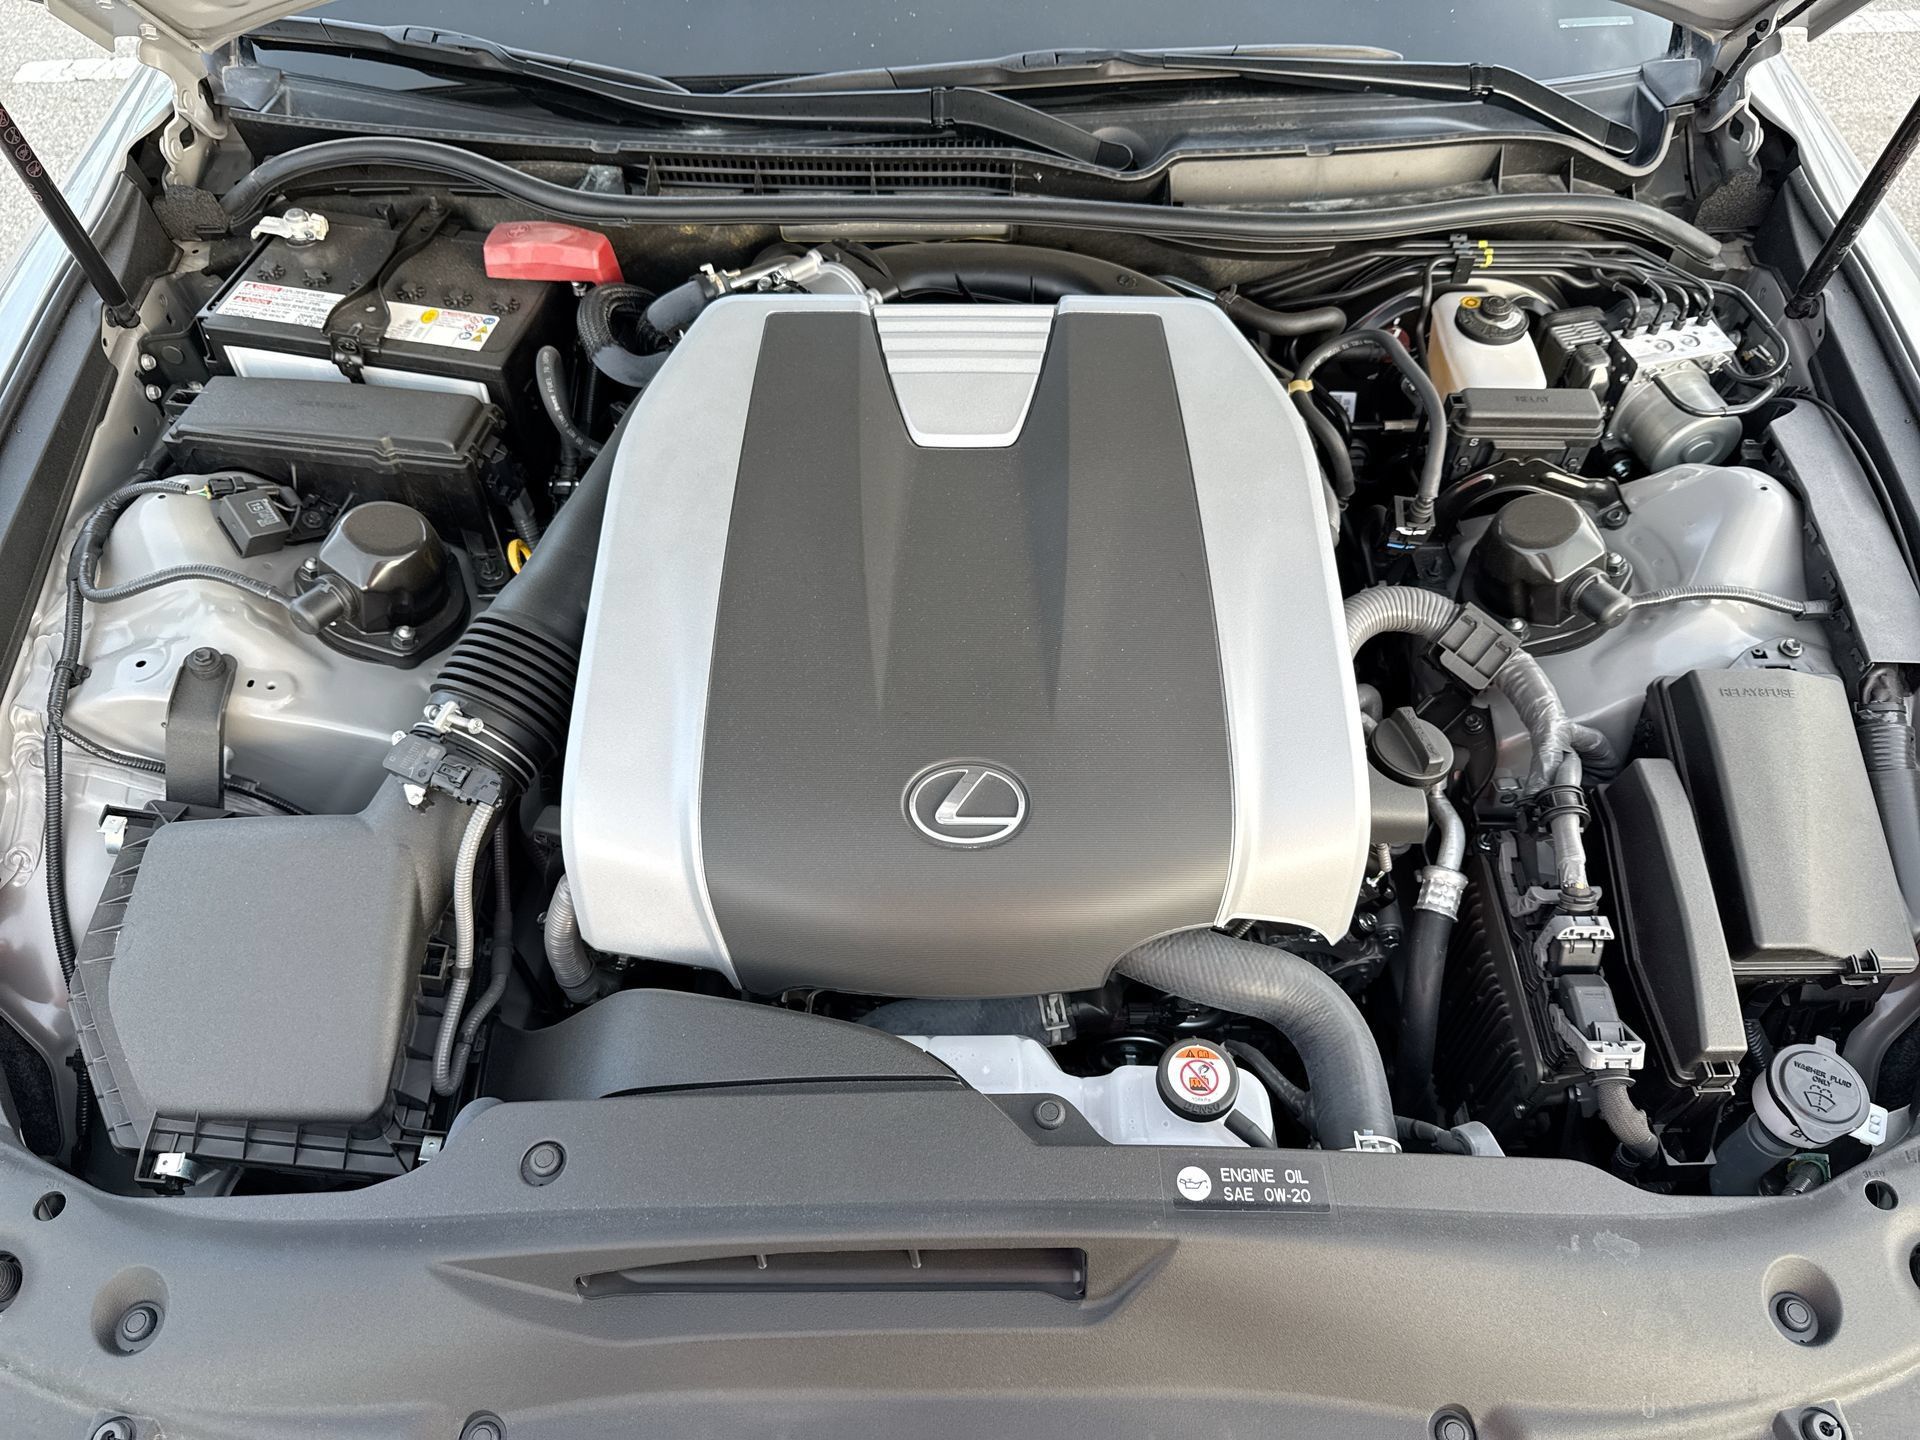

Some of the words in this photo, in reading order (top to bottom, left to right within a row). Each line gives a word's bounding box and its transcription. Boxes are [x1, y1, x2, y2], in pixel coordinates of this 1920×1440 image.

[1469, 438, 1480, 447] S
[250, 502, 264, 511] 15
[1719, 687, 1797, 699] RELAY&FUSE
[1793, 1060, 1827, 1079] WASHER
[1829, 1075, 1852, 1089] FLUID
[1811, 1075, 1831, 1088] ONLY
[1183, 1102, 1221, 1115] DENSO
[1220, 1167, 1276, 1184] ENGINE
[1284, 1169, 1310, 1185] OIL
[1223, 1187, 1255, 1202] SAE
[1263, 1188, 1312, 1203] 0W-20
